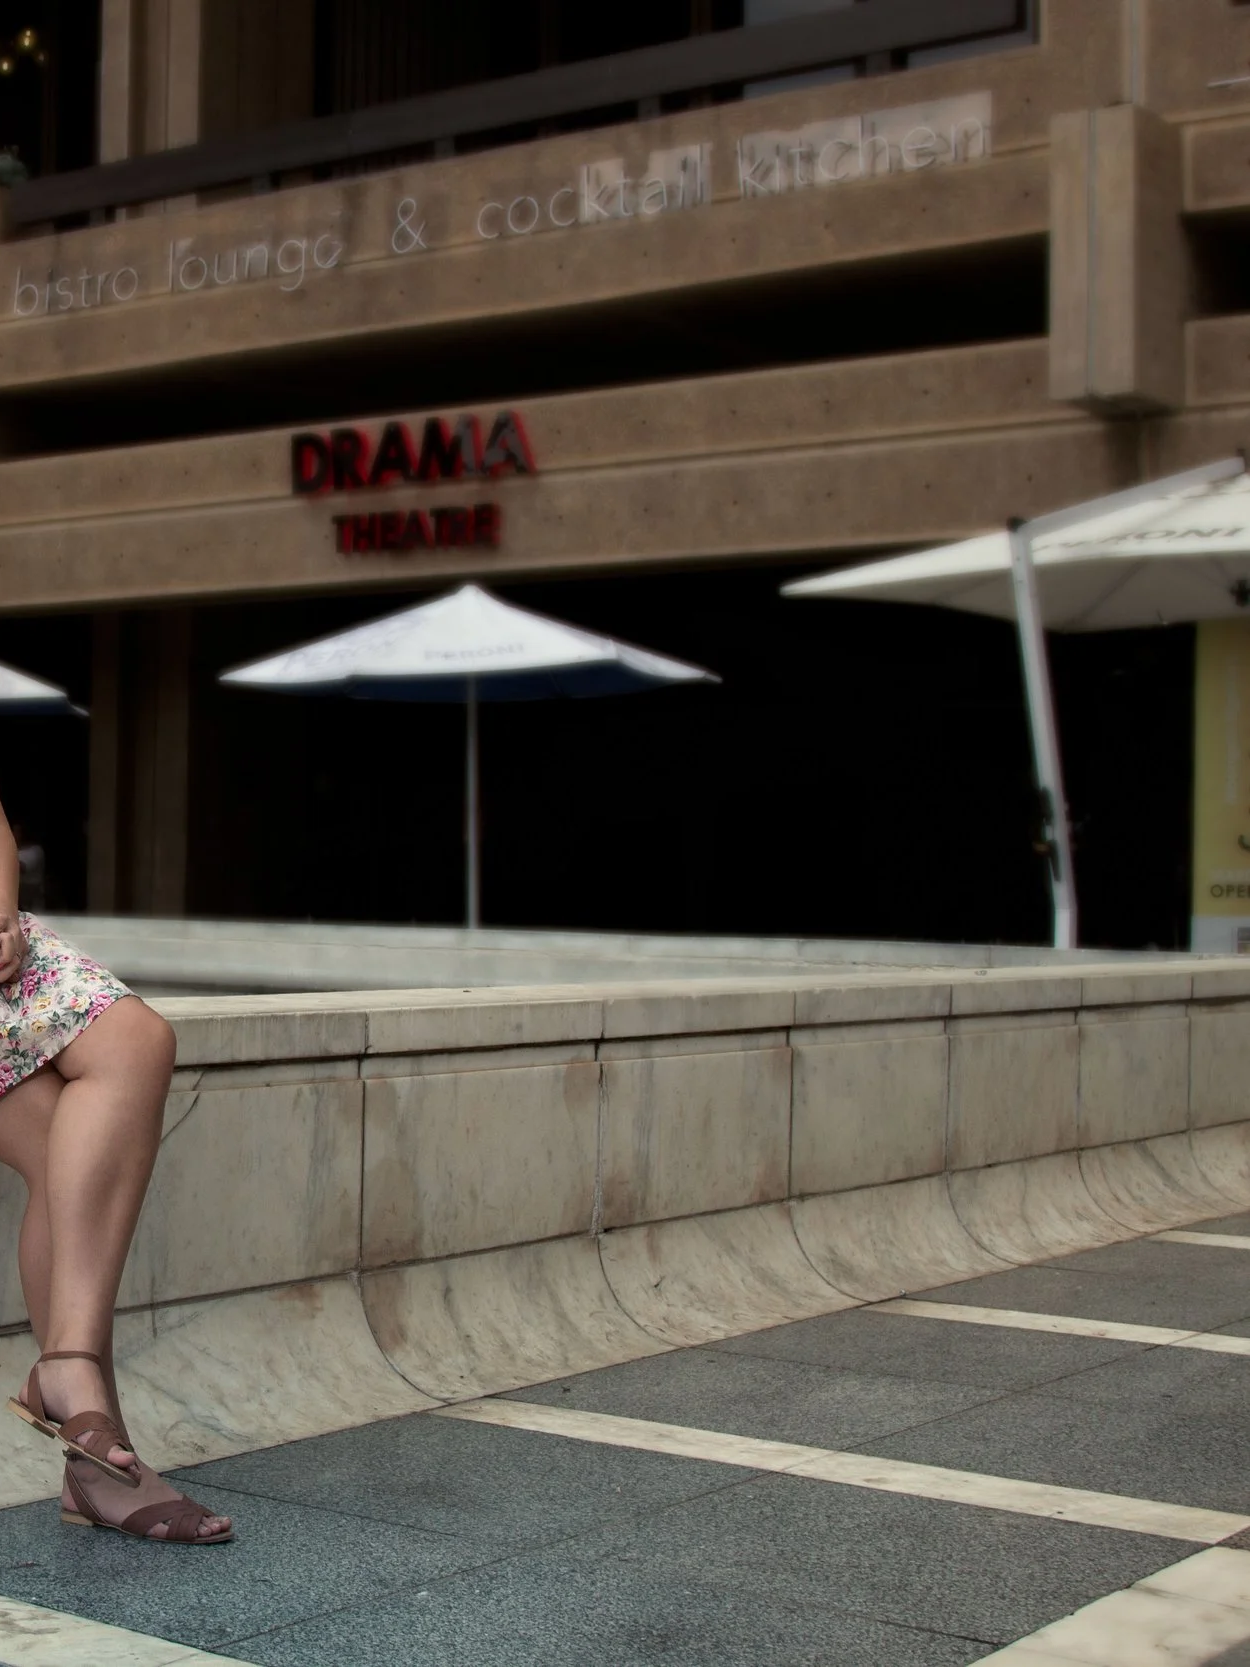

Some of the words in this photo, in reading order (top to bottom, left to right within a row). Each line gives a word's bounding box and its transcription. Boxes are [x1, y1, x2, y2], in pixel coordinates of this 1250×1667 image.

[12, 266, 139, 317] bistro
[390, 197, 428, 254] &
[475, 143, 705, 240] cocktail
[736, 114, 989, 198] kitchen
[291, 410, 536, 499] DRAMA
